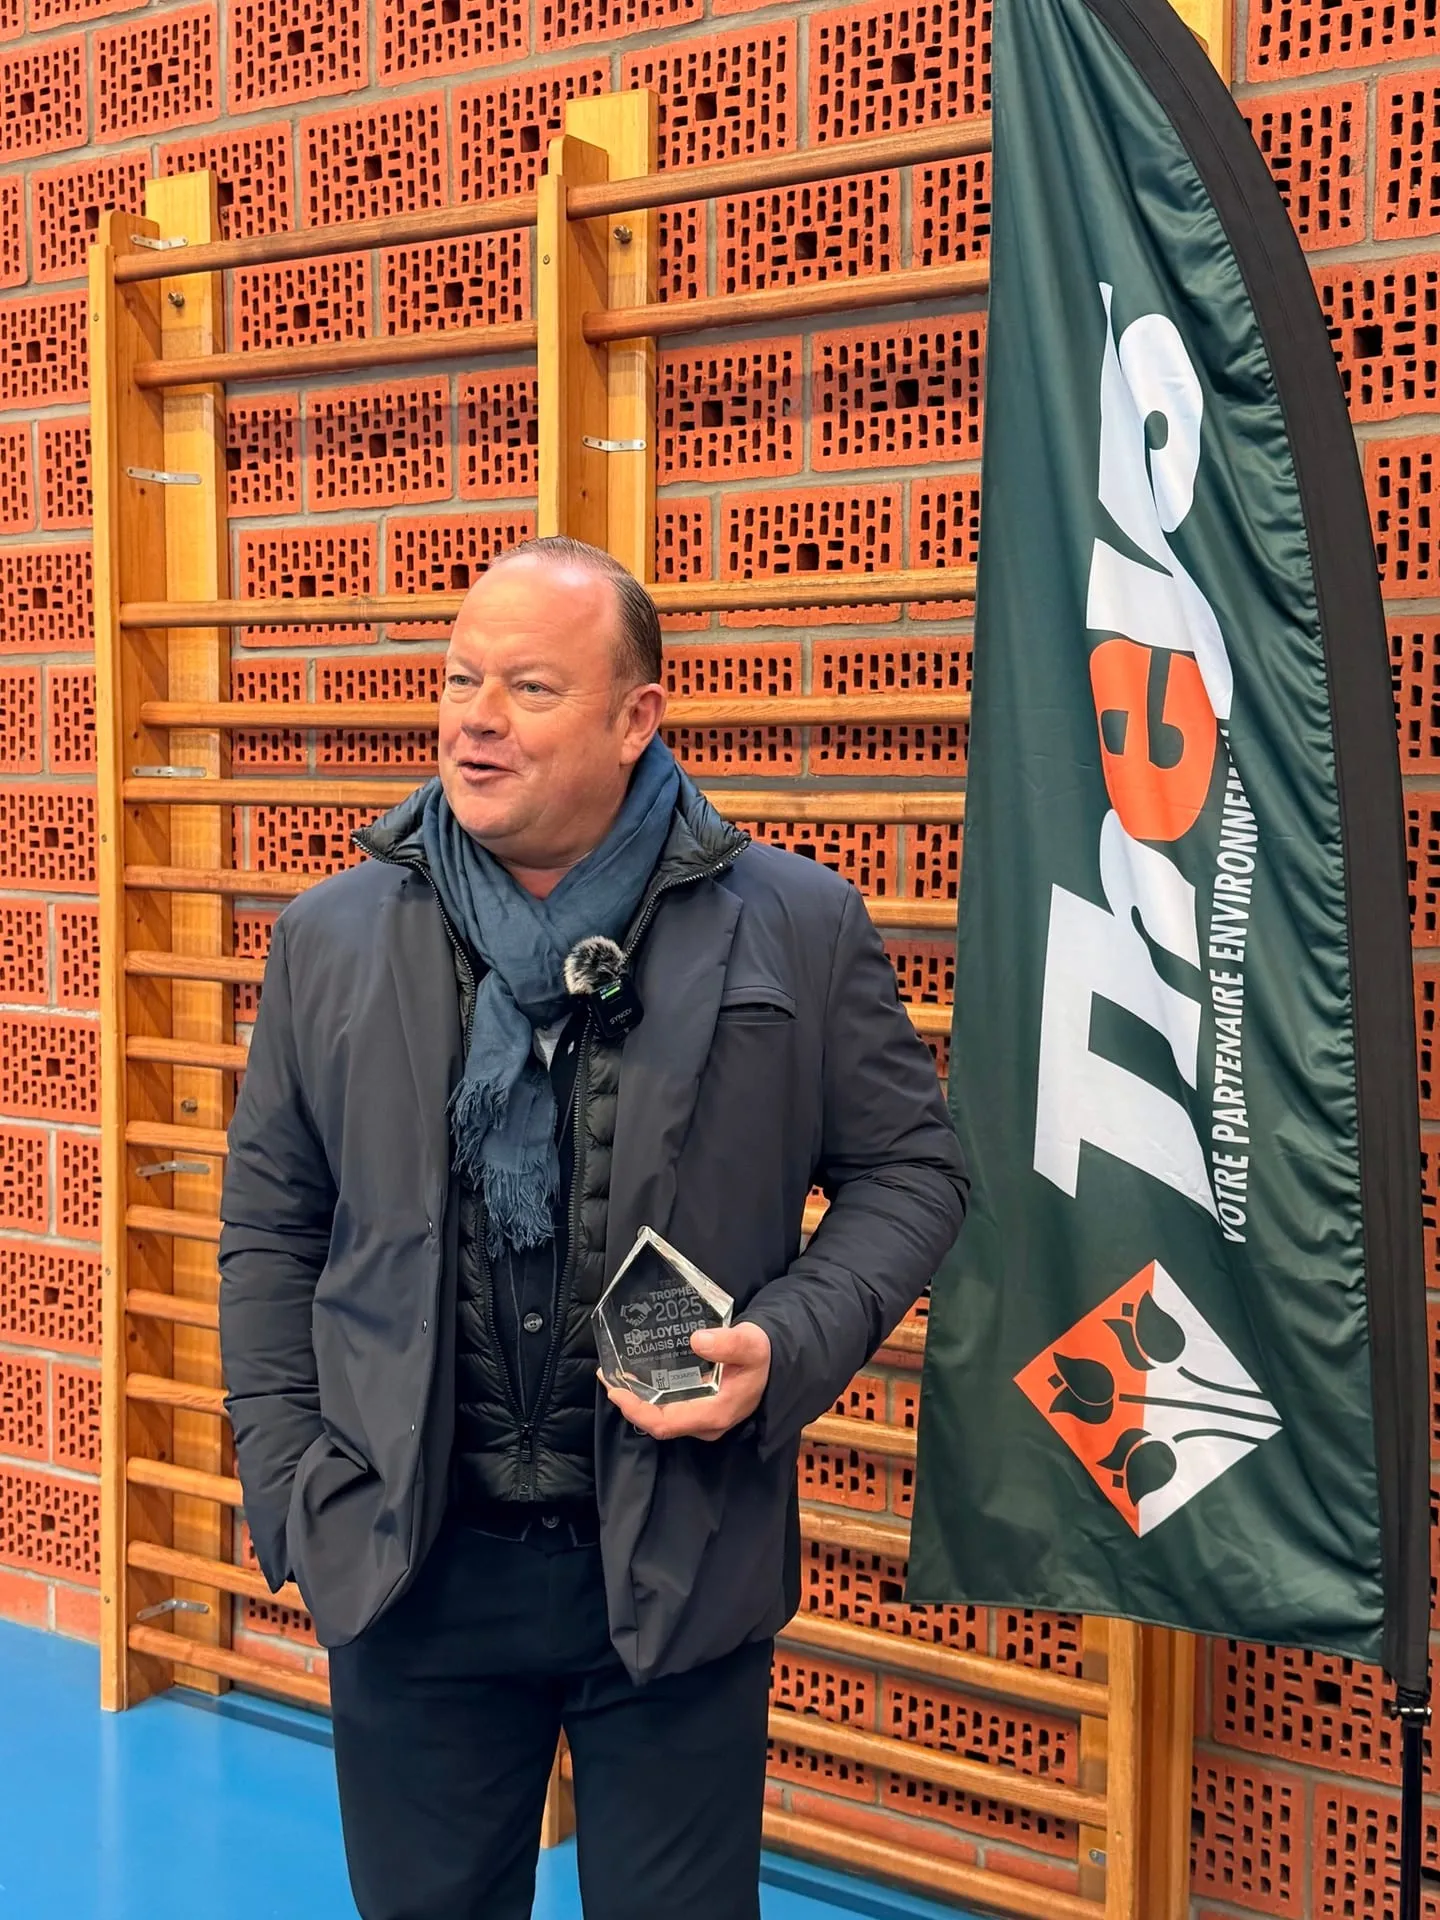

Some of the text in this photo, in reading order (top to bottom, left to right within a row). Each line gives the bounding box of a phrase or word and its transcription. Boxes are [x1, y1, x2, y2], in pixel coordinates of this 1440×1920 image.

[1208, 727, 1259, 1244] VOTRE PARTENAIRE ENVIRONNE
[653, 1295, 704, 1323] 2025
[626, 1339, 675, 1357] DOUAISIS
